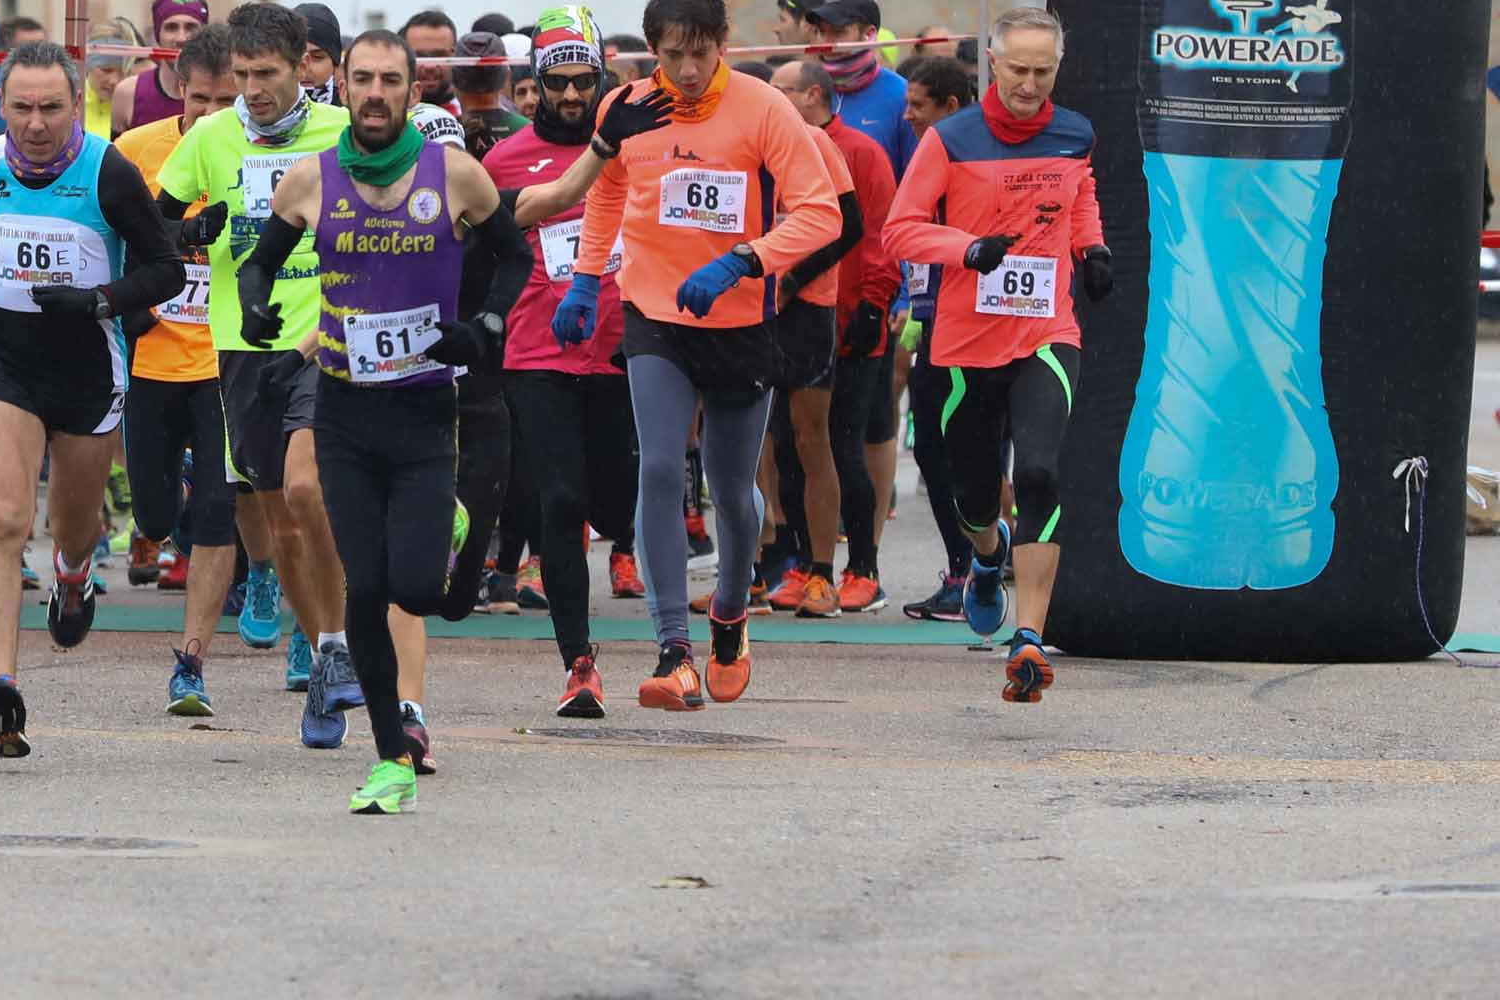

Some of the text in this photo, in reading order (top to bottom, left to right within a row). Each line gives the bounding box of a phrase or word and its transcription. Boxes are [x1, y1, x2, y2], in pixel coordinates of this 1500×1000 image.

[1212, 75, 1282, 85] ICE STORM
[687, 182, 719, 210] 68
[335, 228, 436, 255] Macotera
[17, 241, 51, 270] 66
[56, 249, 70, 266] E
[1003, 270, 1035, 297] 69
[375, 327, 411, 358] 61
[357, 354, 428, 375] JOMISAG
